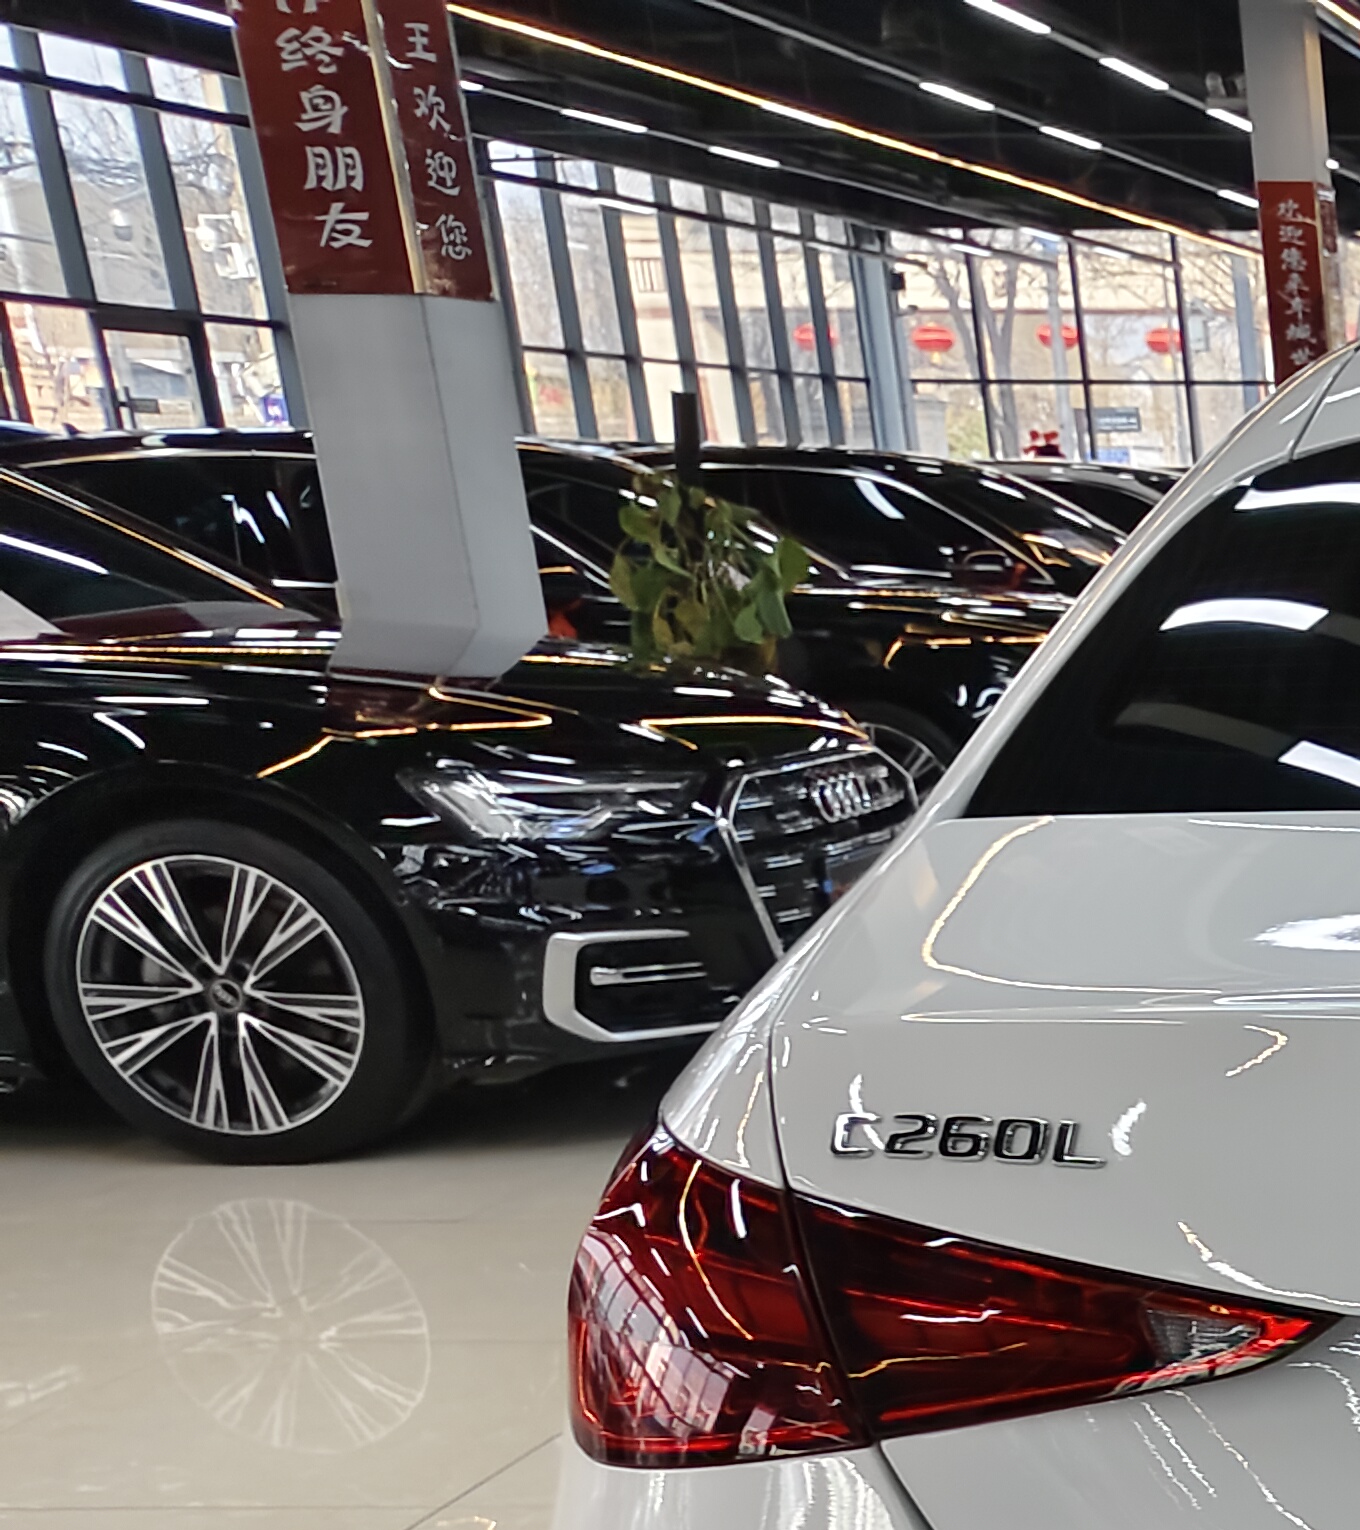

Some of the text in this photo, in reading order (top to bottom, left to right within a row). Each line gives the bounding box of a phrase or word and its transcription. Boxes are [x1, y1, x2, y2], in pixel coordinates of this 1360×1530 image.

[403, 22, 473, 261] 王欢迎您
[830, 1112, 1108, 1169] C260L
